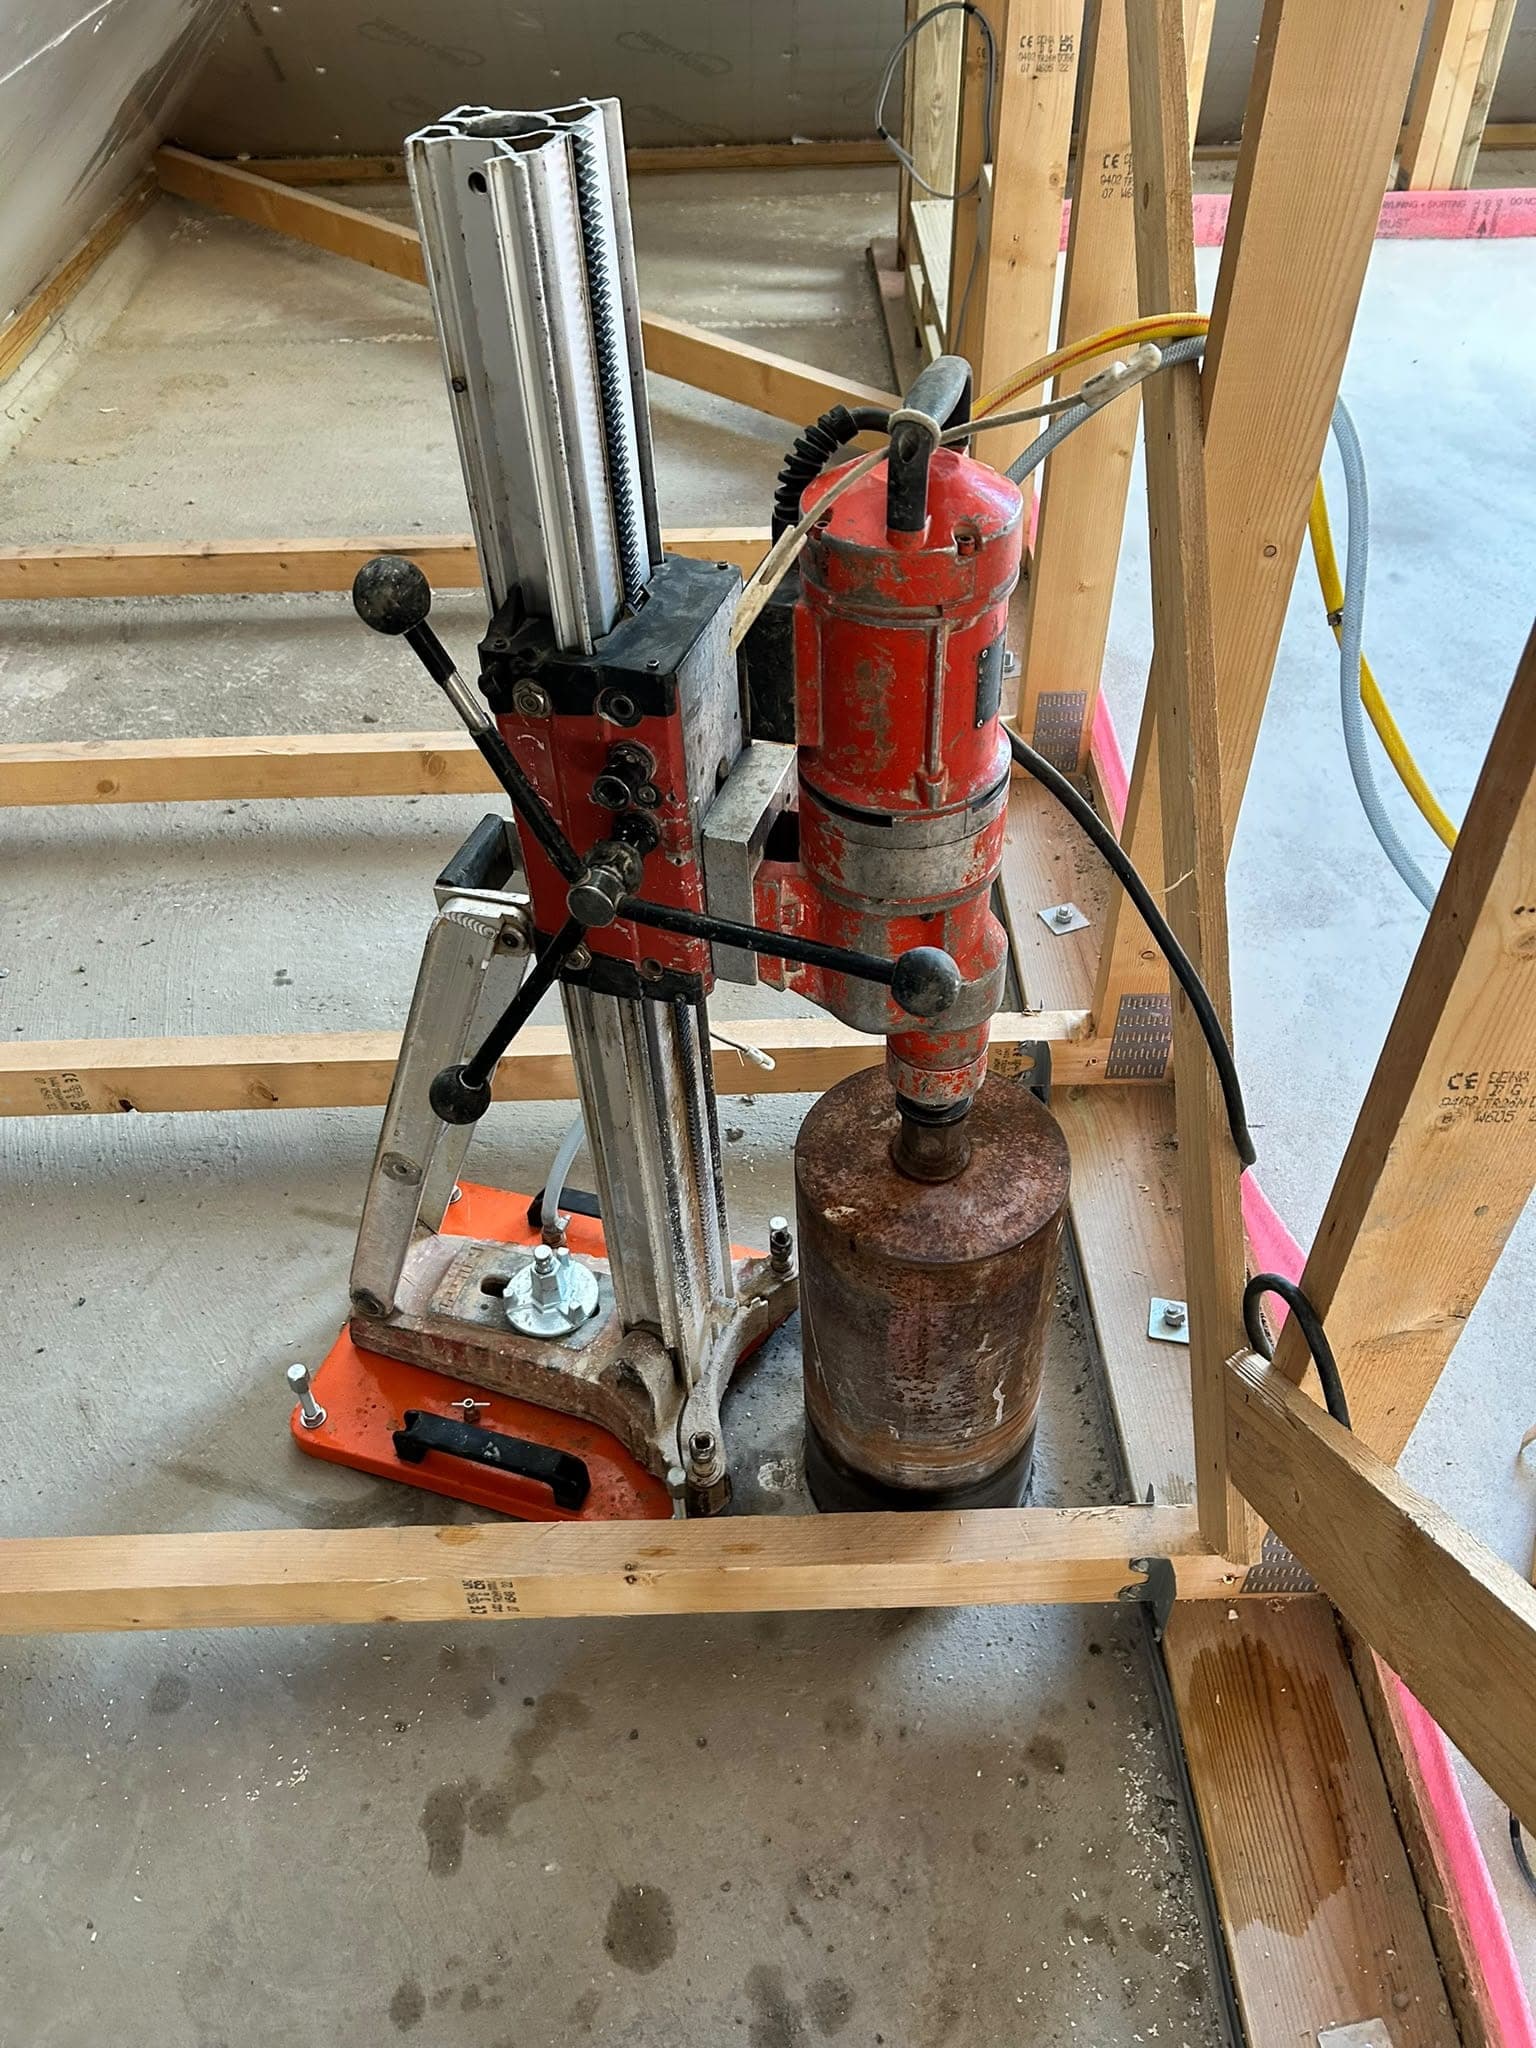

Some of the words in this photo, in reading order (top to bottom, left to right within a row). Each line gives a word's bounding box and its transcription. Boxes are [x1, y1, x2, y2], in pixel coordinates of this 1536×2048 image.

[1020, 35, 1034, 48] CE
[1103, 153, 1120, 169] CE
[1447, 1072, 1479, 1090] CE
[470, 1605, 488, 1614] CE
